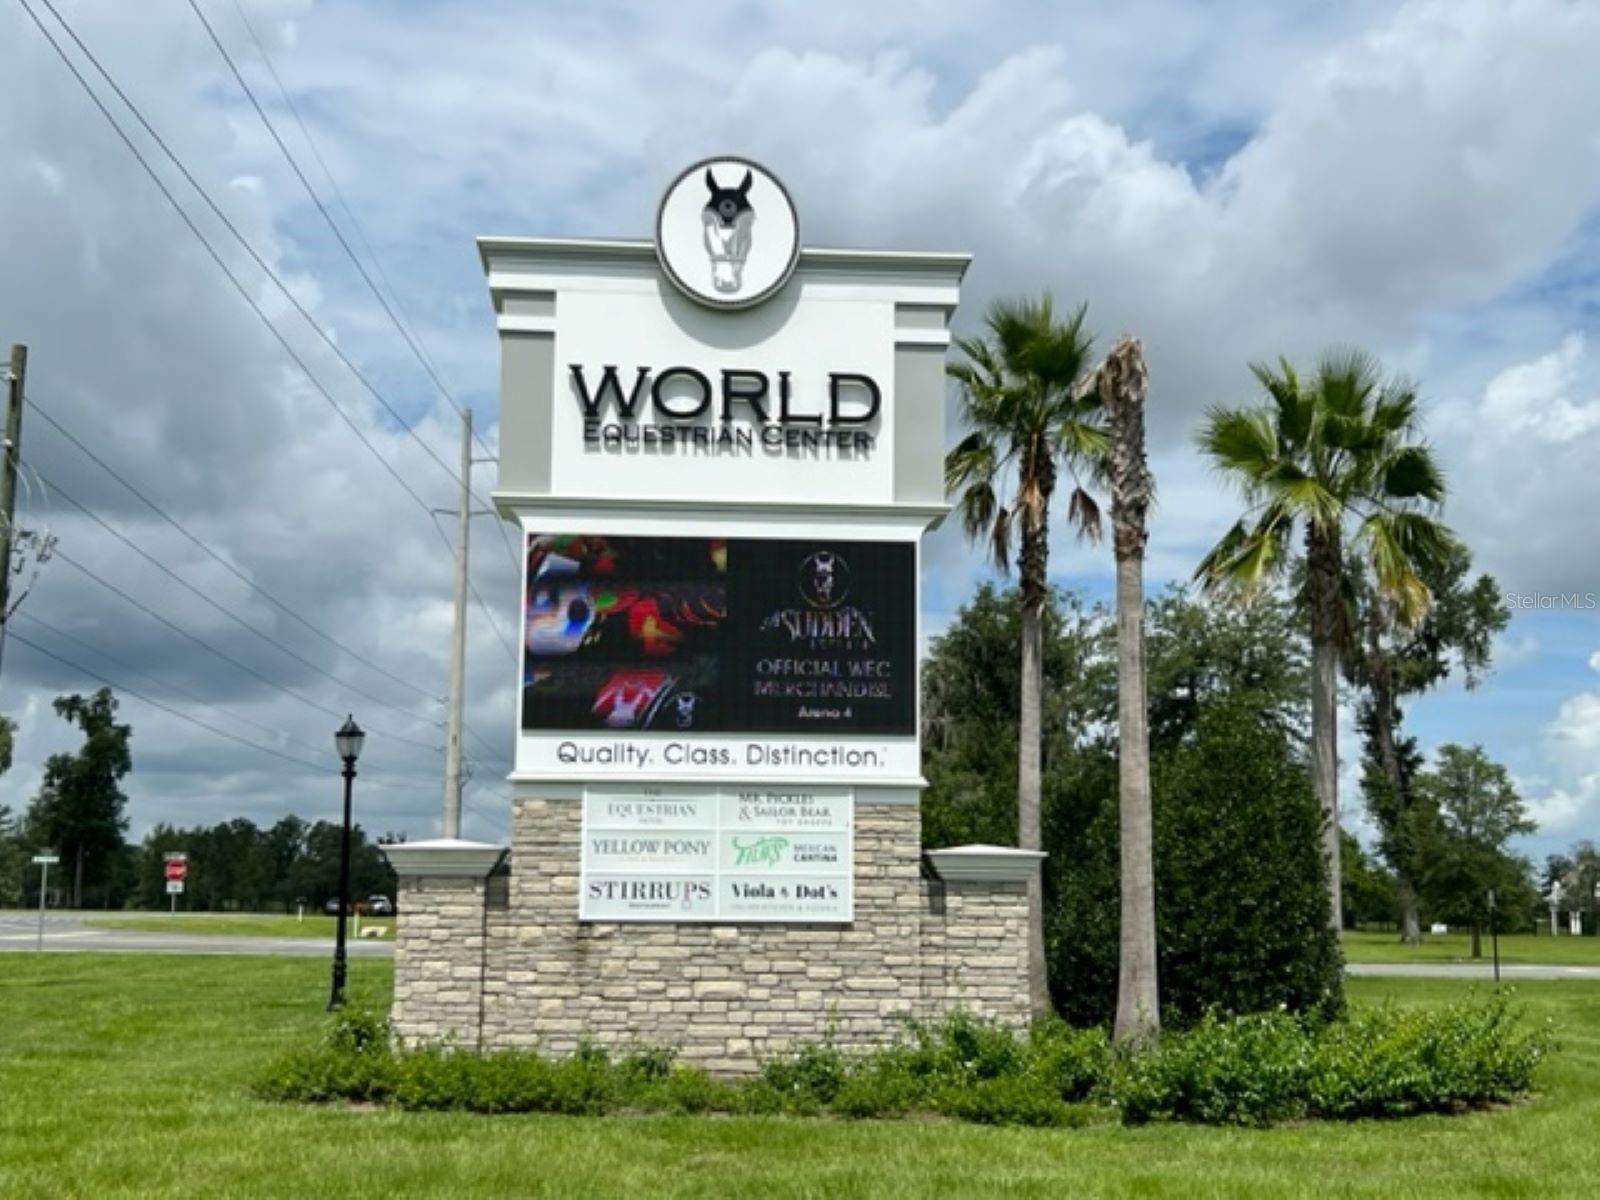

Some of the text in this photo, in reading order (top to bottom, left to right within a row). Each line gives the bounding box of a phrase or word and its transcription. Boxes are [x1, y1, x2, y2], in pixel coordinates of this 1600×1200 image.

[569, 364, 881, 425] WORLD
[583, 420, 875, 450] EQUESTRIAN CENTER
[756, 658, 841, 676] OFFICIAL
[556, 741, 885, 767] Quality. Class. Distinction.
[607, 803, 697, 817] EQUESTRIAN
[753, 806, 796, 817] SAILOR
[592, 839, 712, 855] YELLOW PONY
[588, 881, 712, 903] STIRRUPS
[731, 883, 776, 898] Viola
[796, 883, 838, 899] Dot's
